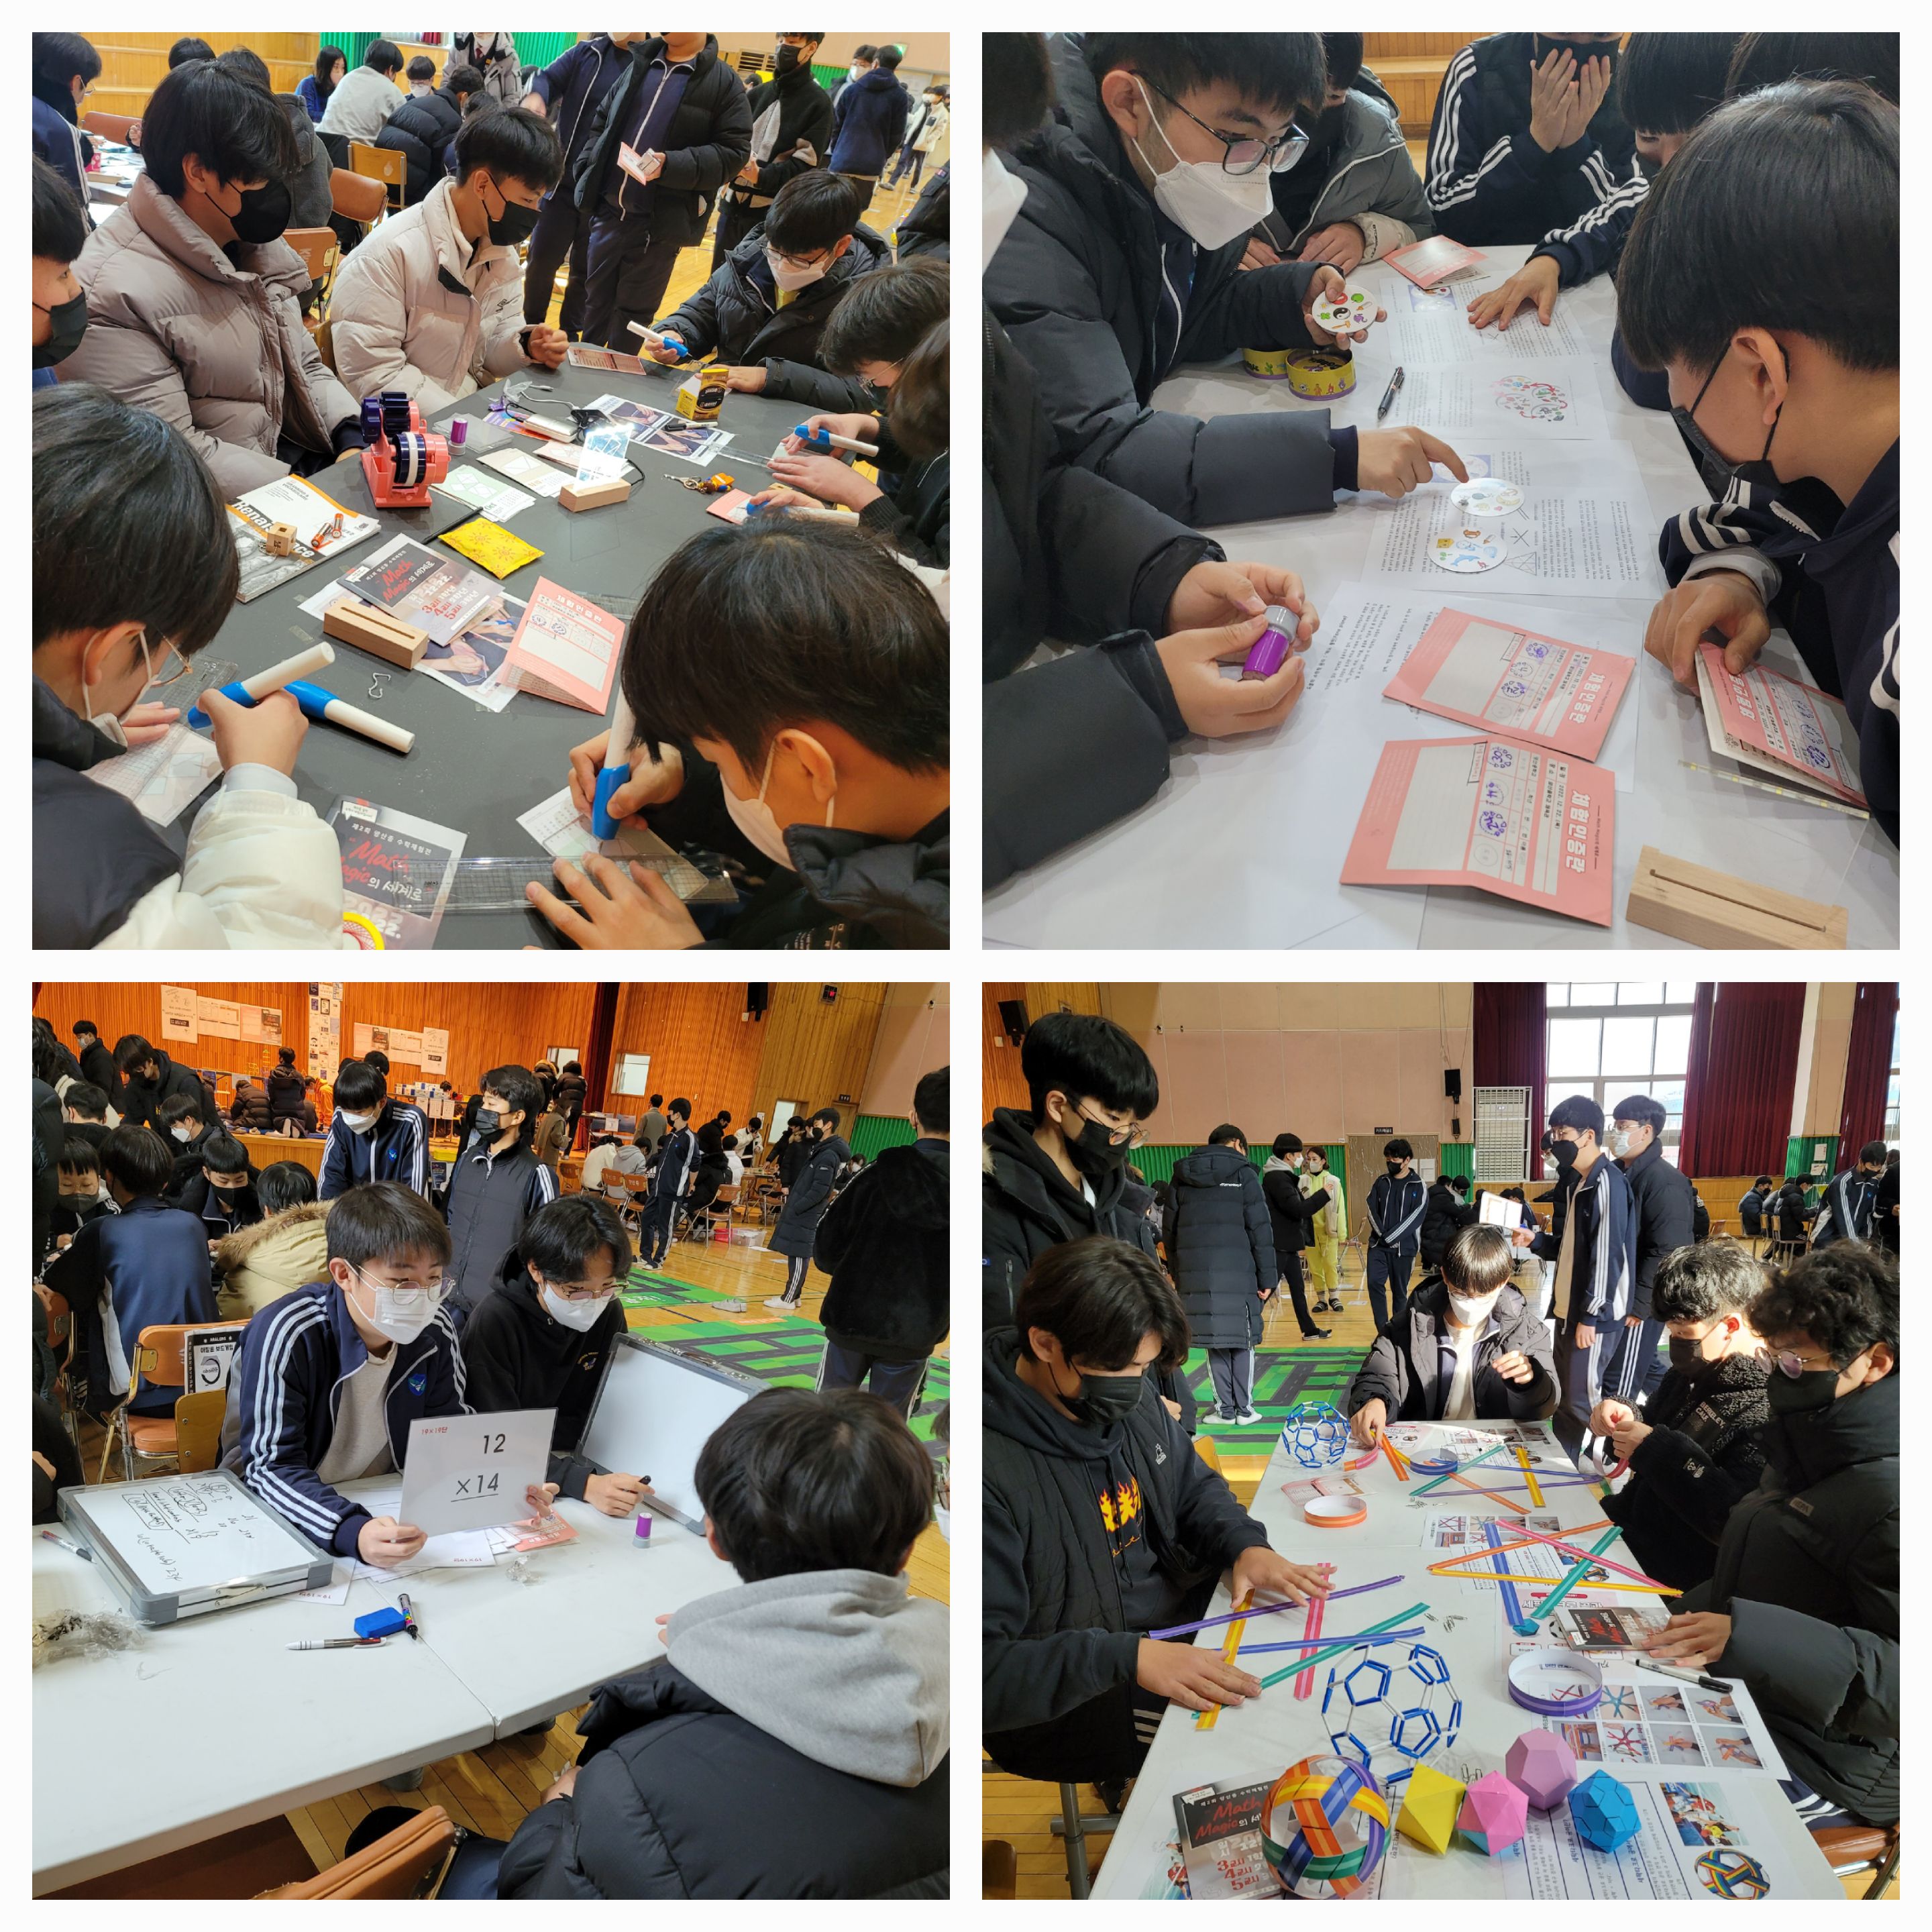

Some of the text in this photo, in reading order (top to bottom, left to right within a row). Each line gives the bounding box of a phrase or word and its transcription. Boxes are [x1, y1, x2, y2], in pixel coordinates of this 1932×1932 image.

[382, 559, 414, 587] Math
[1568, 672, 1605, 724] 체험인증란
[352, 823, 371, 834] 제2회
[397, 839, 432, 855] 수학체험전
[1566, 790, 1590, 873] 체험인증란
[349, 840, 409, 873] Math
[341, 856, 423, 901] agic의 세계로
[483, 1433, 506, 1454] 12
[1213, 1796, 1263, 1822] Math
[1195, 1818, 1248, 1841] Magic의
